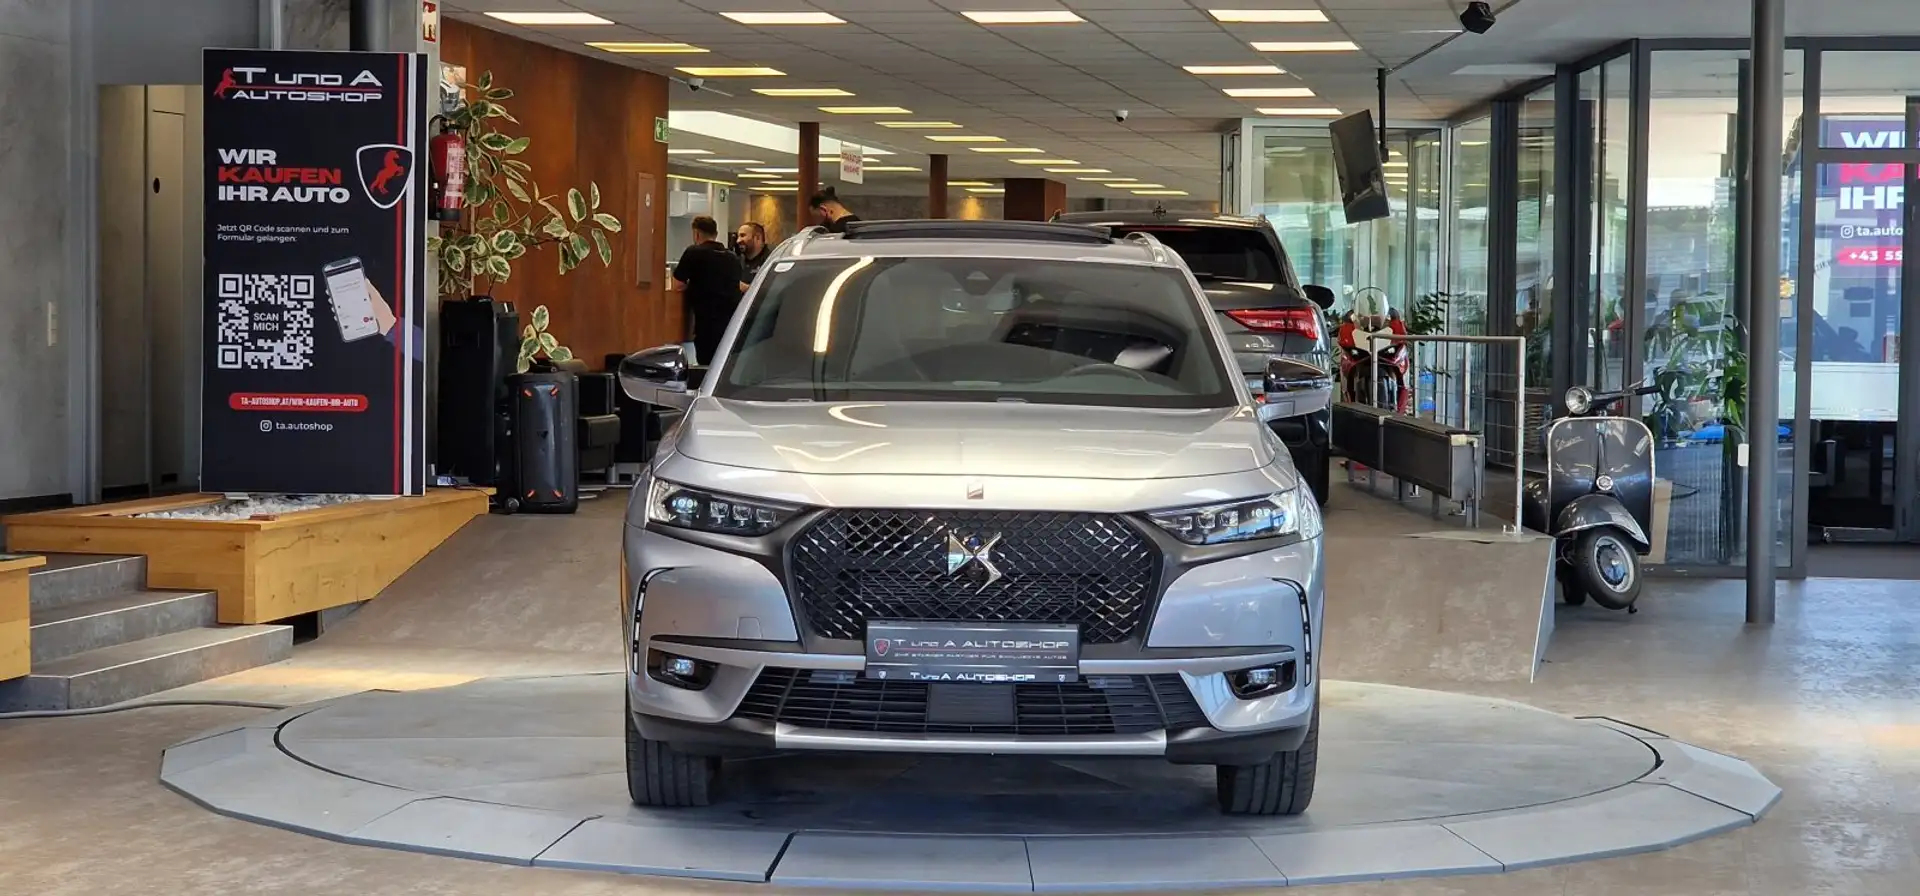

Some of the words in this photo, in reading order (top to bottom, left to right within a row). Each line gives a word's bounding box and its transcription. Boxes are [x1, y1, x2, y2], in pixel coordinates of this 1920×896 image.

[232, 66, 267, 84] T
[350, 70, 382, 86] A
[233, 90, 382, 102] AUTOSHOP
[1840, 131, 1905, 148] WI
[218, 149, 276, 165] WIR
[219, 167, 341, 184] KAUFEN
[218, 185, 268, 202] IHR
[272, 187, 350, 203] AUTO
[217, 223, 238, 232] Jetzt
[239, 224, 252, 233] QR
[254, 224, 275, 233] Code
[312, 225, 329, 234] und
[1849, 251, 1879, 261] +43
[253, 312, 280, 322] SCAN
[253, 322, 280, 331] MICH
[275, 422, 334, 432] ta.autoshop
[893, 638, 908, 647] T
[944, 639, 957, 648] A
[961, 639, 1069, 649] AUTOSHOP
[910, 671, 920, 681] T
[939, 673, 952, 681] A
[956, 673, 1036, 682] AUTOSHOP
